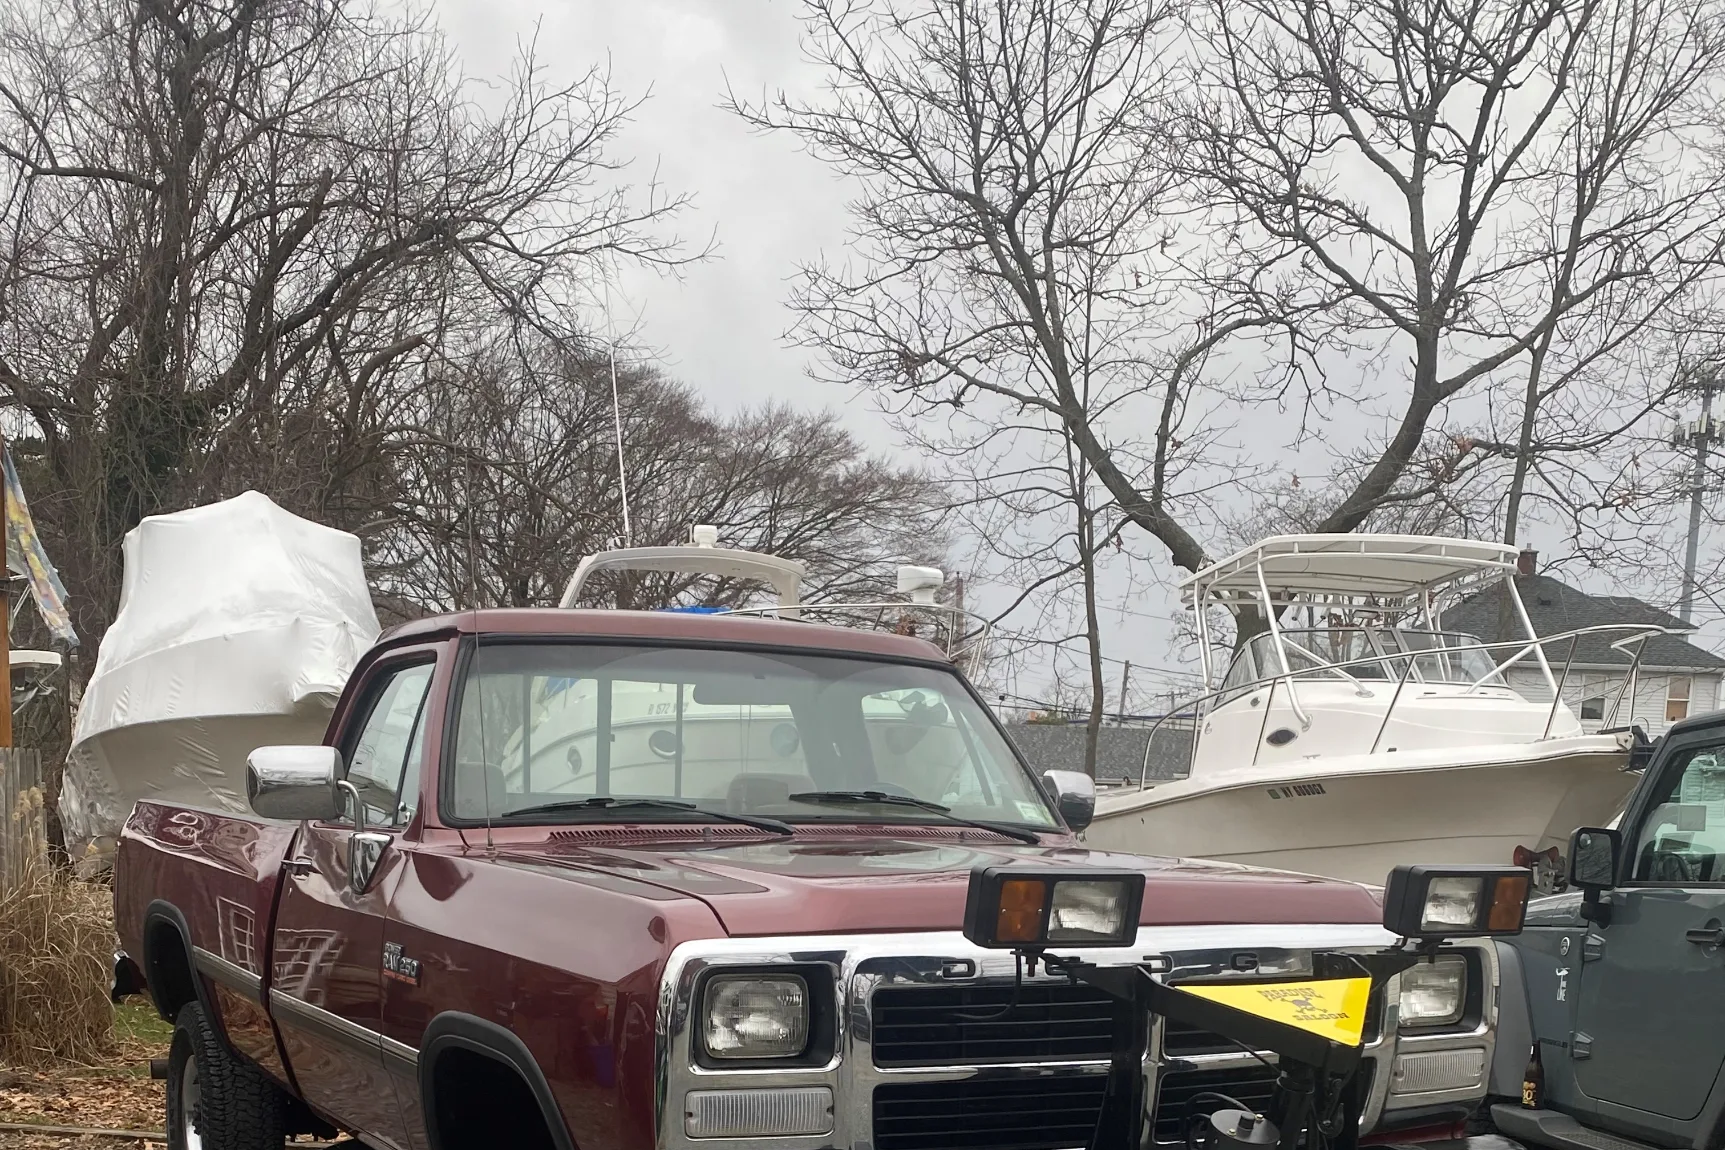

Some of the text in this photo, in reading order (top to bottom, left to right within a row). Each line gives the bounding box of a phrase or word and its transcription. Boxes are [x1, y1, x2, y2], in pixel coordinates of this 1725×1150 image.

[400, 956, 419, 977] 250
[1257, 987, 1326, 1002] PARADISE
[1292, 1012, 1351, 1021] SALOON
